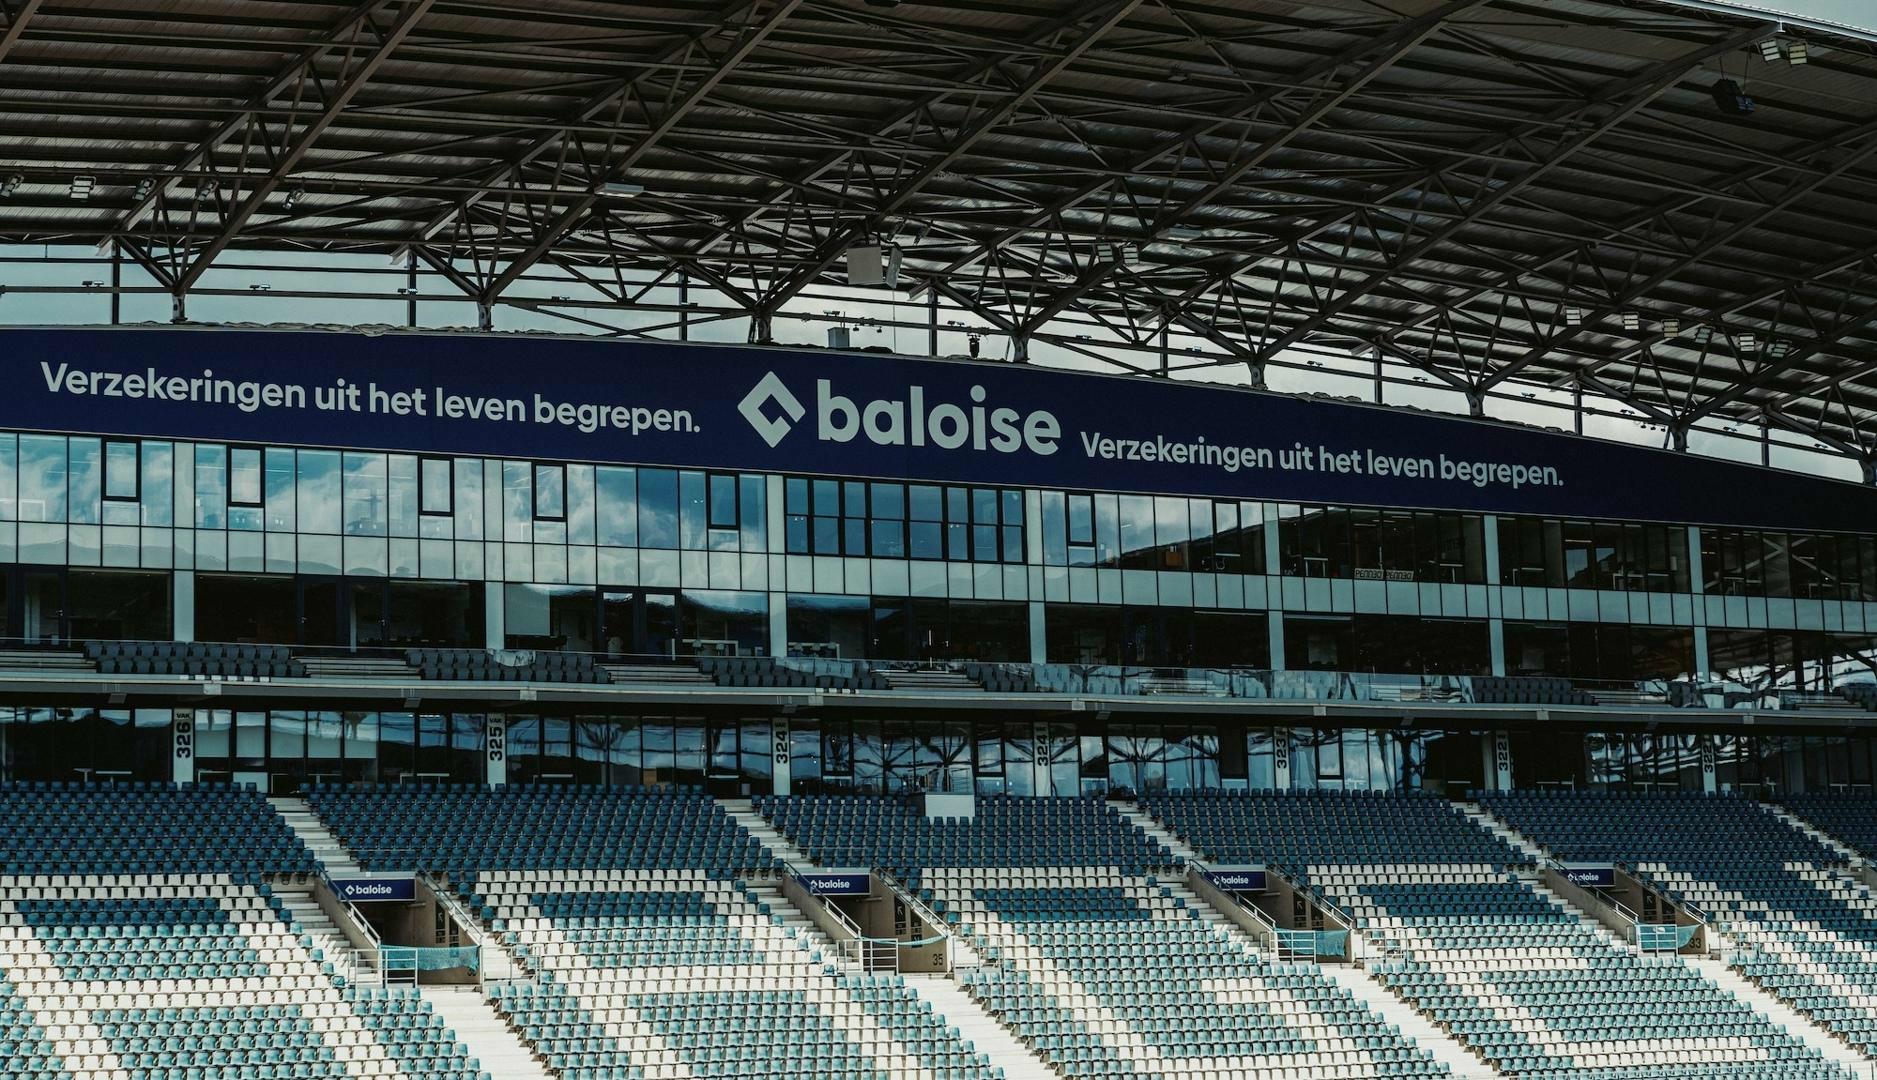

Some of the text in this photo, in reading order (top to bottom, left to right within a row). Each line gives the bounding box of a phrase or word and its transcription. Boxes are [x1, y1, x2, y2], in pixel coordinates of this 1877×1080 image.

[41, 361, 701, 436] Verzekeringen uit het leven begrepen.
[817, 378, 1061, 456] baloise
[1081, 431, 1564, 489] Verzekeringen uit het leven begrepen.
[176, 712, 191, 720] VAK
[176, 721, 191, 760] 326
[490, 726, 503, 761] 325
[776, 730, 788, 764] 324
[1037, 734, 1049, 767] 324
[1276, 737, 1288, 769] 323
[1498, 740, 1509, 772] 322
[355, 883, 393, 895] baloise
[818, 878, 851, 889] baloise
[1221, 875, 1249, 884] baloise
[1689, 937, 1702, 949] 33
[932, 953, 944, 966] 35
